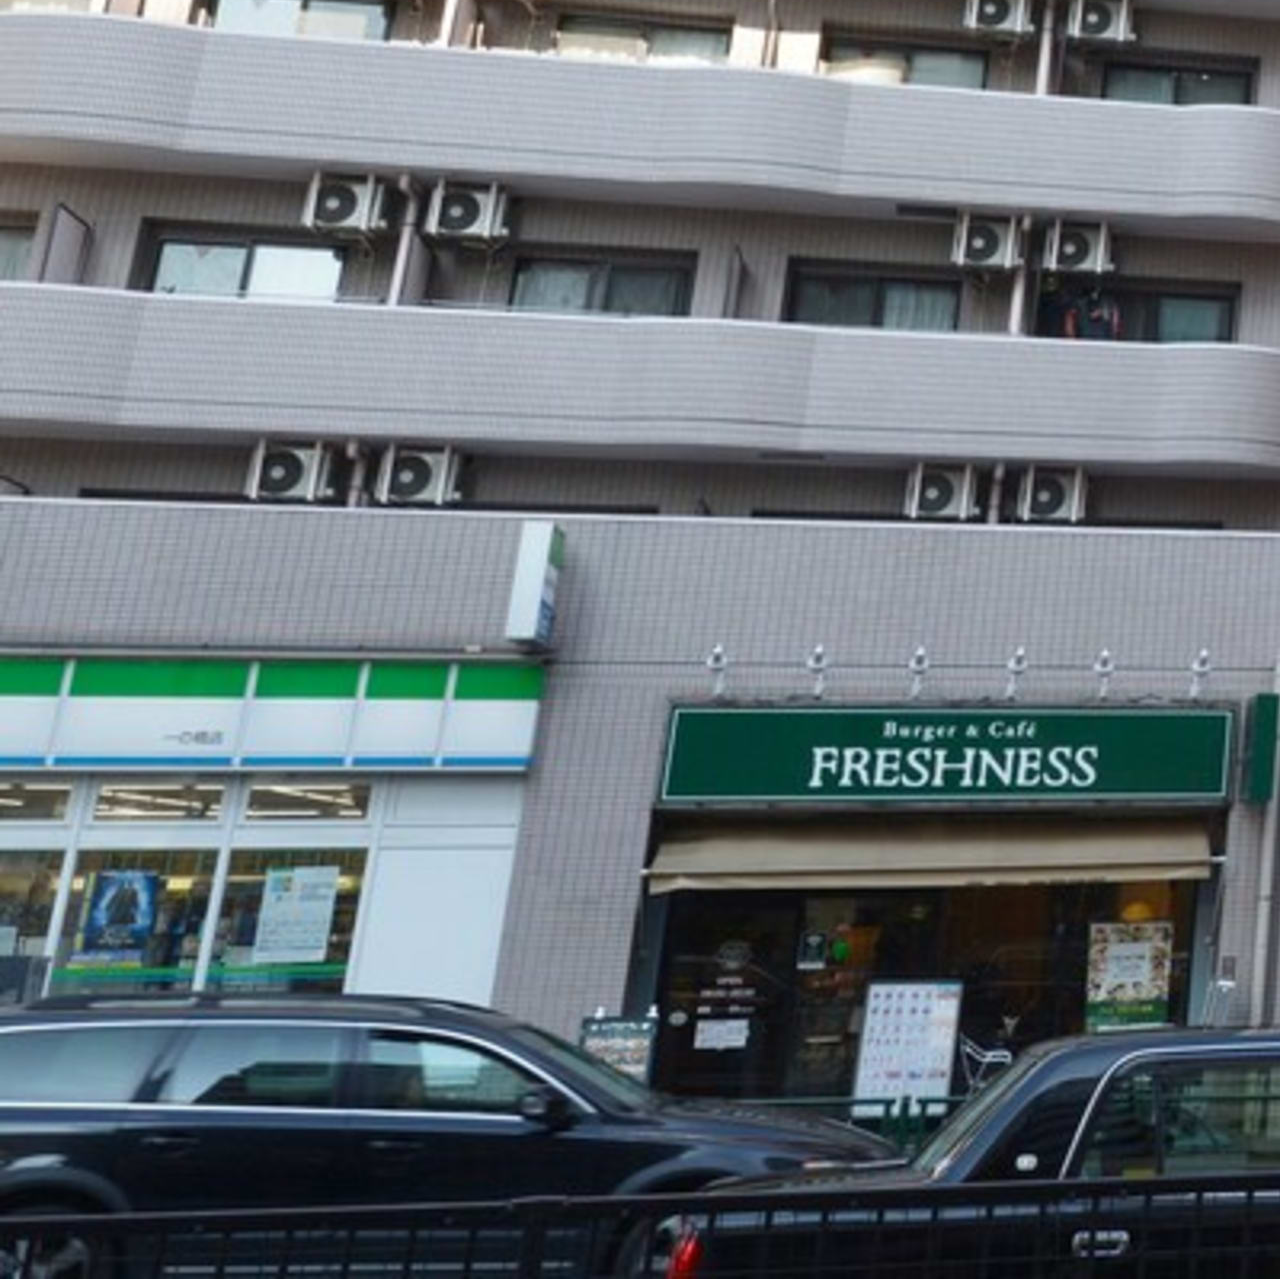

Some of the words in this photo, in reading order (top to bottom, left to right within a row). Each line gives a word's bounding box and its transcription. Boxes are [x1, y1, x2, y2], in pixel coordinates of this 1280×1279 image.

[882, 721, 957, 742] Burger
[988, 721, 1037, 738] Café
[808, 746, 1099, 788] FRESHNESS
